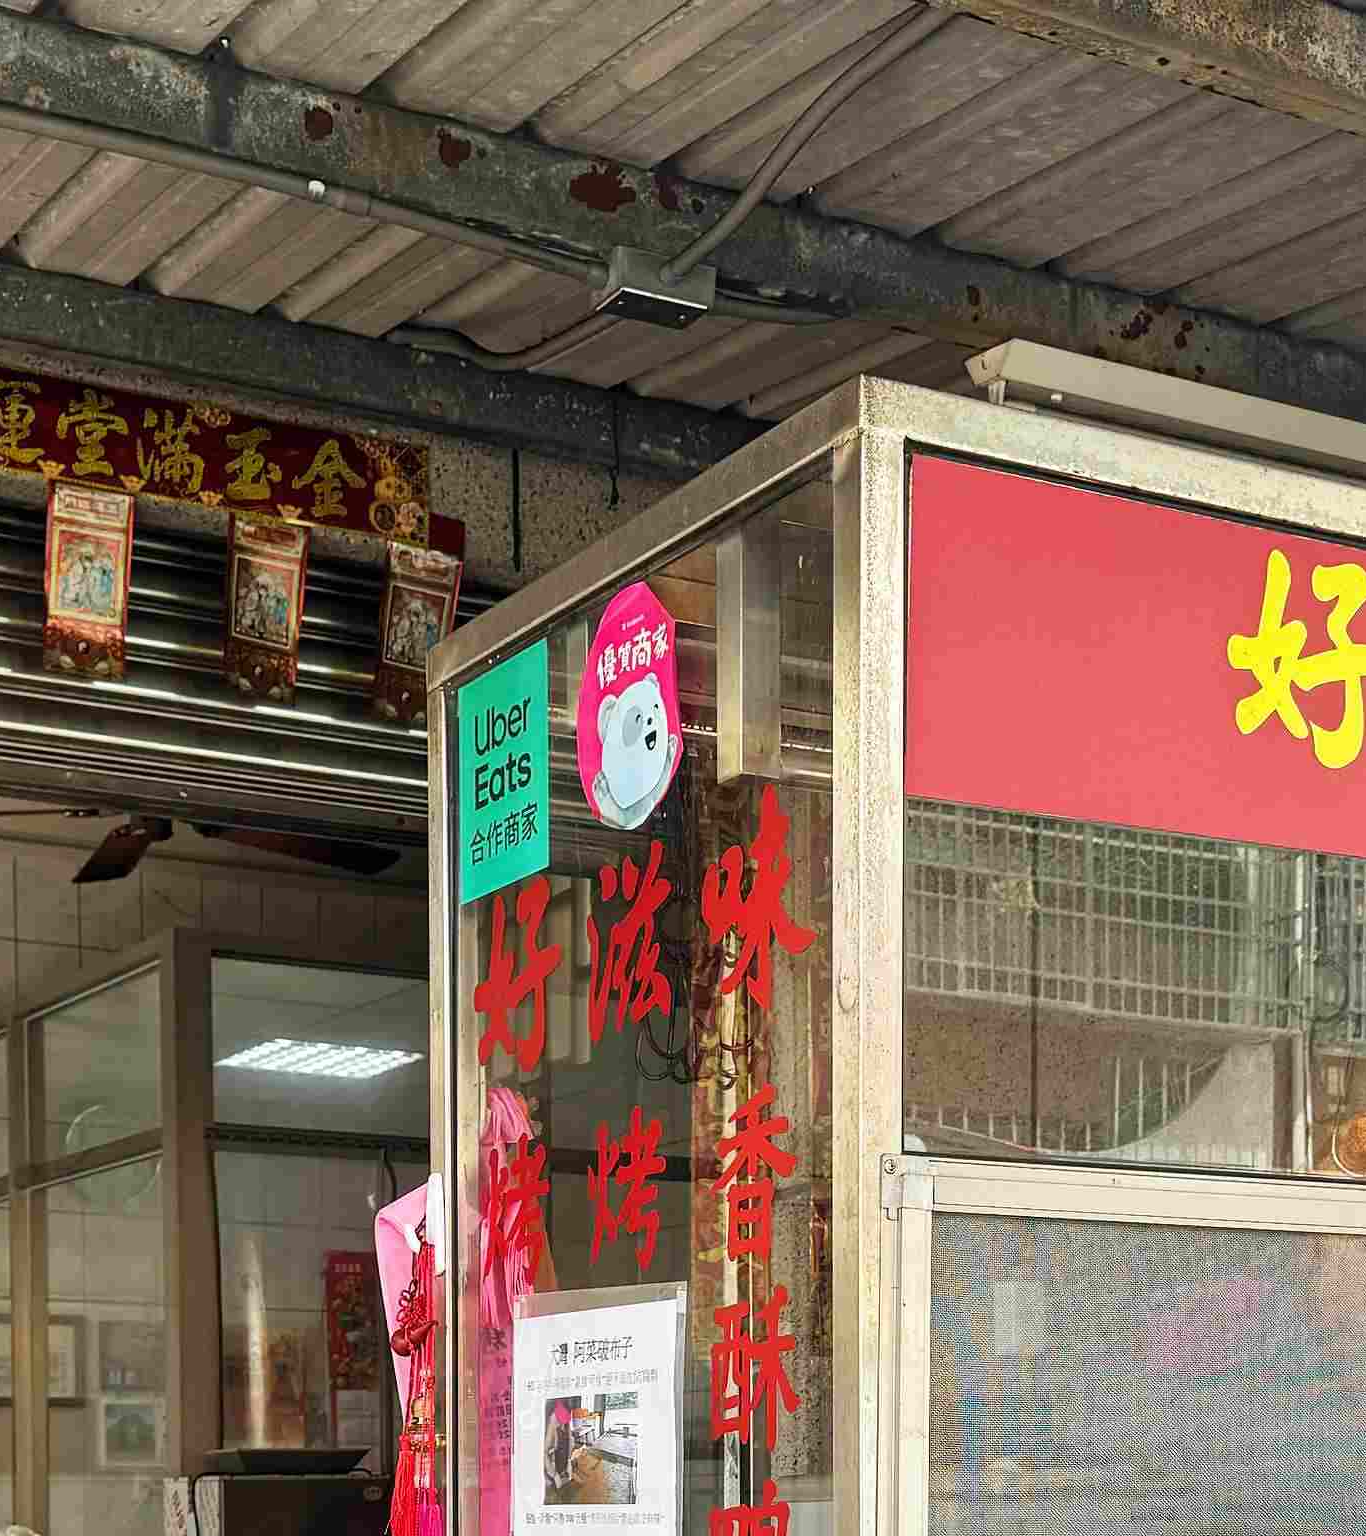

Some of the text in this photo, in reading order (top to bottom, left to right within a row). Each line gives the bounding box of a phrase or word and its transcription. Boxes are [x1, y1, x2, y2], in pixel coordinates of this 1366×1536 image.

[597, 622, 668, 690] 優質商家
[474, 696, 530, 756] Uber
[474, 750, 531, 812] Eats
[470, 801, 538, 866] 合作商家
